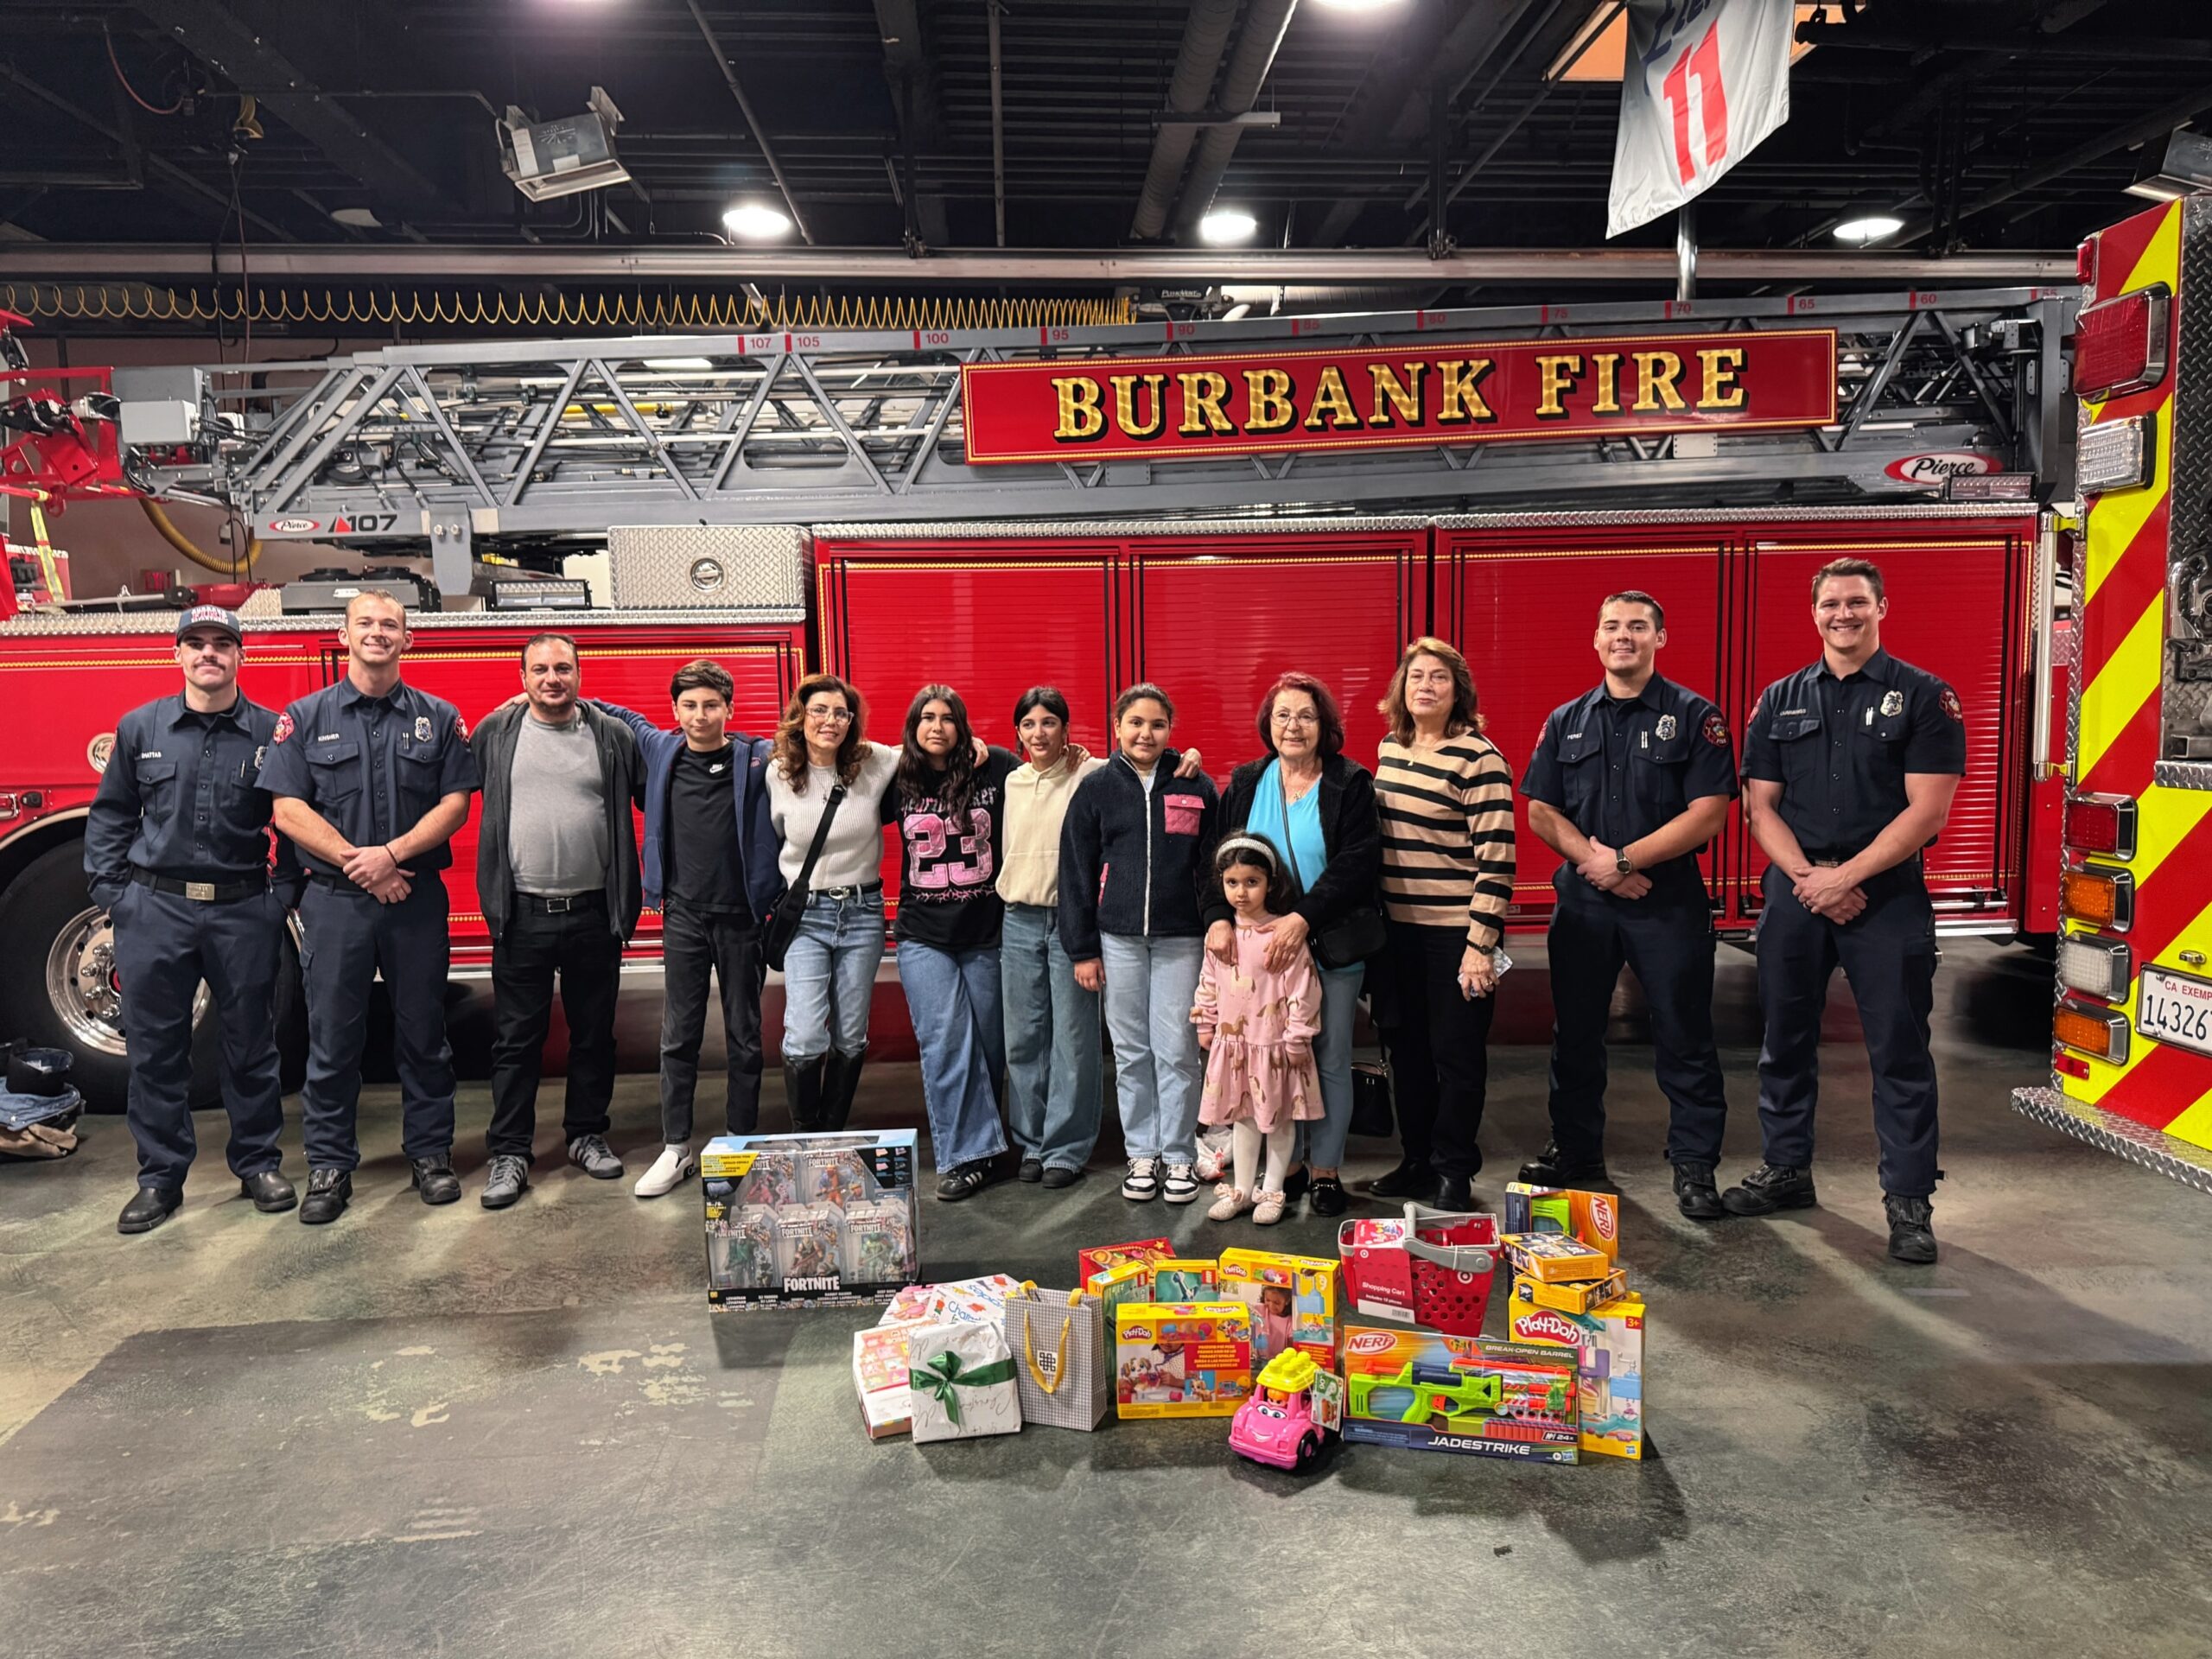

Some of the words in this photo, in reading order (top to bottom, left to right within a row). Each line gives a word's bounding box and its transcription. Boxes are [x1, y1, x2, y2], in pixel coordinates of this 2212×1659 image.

[1663, 18, 1728, 186] 11
[1798, 299, 1815, 309] 65
[1920, 293, 1937, 304] 60
[1554, 308, 1568, 319] 75
[1676, 303, 1692, 314] 70
[1177, 324, 1195, 335] 90
[1303, 319, 1320, 330] 85
[925, 333, 949, 344] 100
[1052, 328, 1069, 340] 95
[749, 337, 771, 349] 107
[797, 335, 820, 347] 105
[1051, 359, 1495, 442] BURBANK
[1535, 348, 1747, 416] FIRE
[1910, 457, 1976, 479] Pierce
[903, 807, 993, 889] 23
[2164, 981, 2177, 992] CA
[2182, 984, 2212, 1001] EXEMP
[2143, 994, 2212, 1041] 14326
[808, 1157, 839, 1167] FORTNITE
[1592, 1195, 1612, 1239] NERF
[781, 1227, 813, 1237] FORTNITE
[850, 1223, 882, 1233] FORTNITE
[783, 1275, 840, 1294] FORTNITE
[1362, 1281, 1391, 1294] Shopping
[1391, 1287, 1406, 1296] Cart
[1627, 1317, 1640, 1327] 3+
[1122, 1327, 1152, 1339] Play-Doh
[1515, 1315, 1579, 1343] Play-Doh
[1347, 1336, 1397, 1350] NERF
[1485, 1344, 1539, 1355] BREAK-OPEN
[1540, 1350, 1574, 1359] BARREL
[1427, 1435, 1530, 1455] JADESTRIKE
